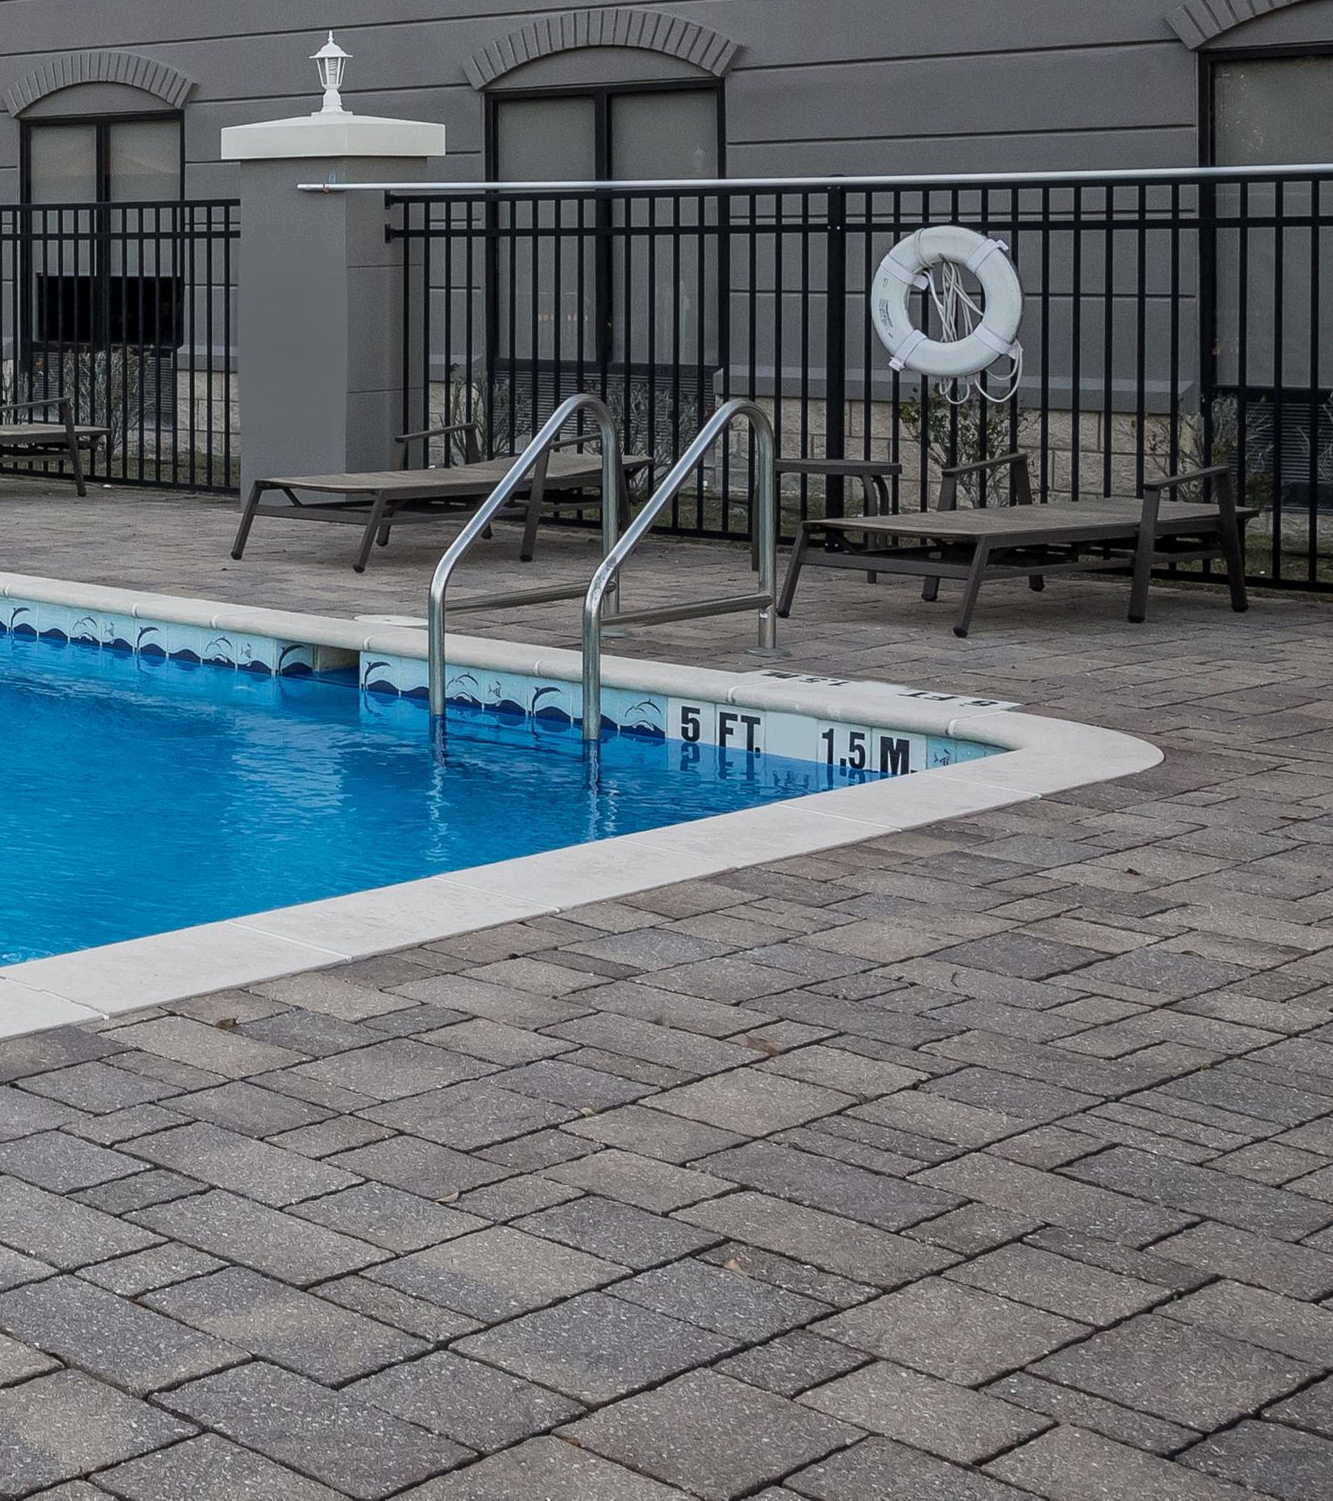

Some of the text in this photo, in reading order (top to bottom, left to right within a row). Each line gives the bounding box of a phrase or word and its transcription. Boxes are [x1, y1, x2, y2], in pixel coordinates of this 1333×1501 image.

[681, 705, 700, 742] 5
[719, 712, 761, 755] FT.
[822, 728, 866, 770] 1.5
